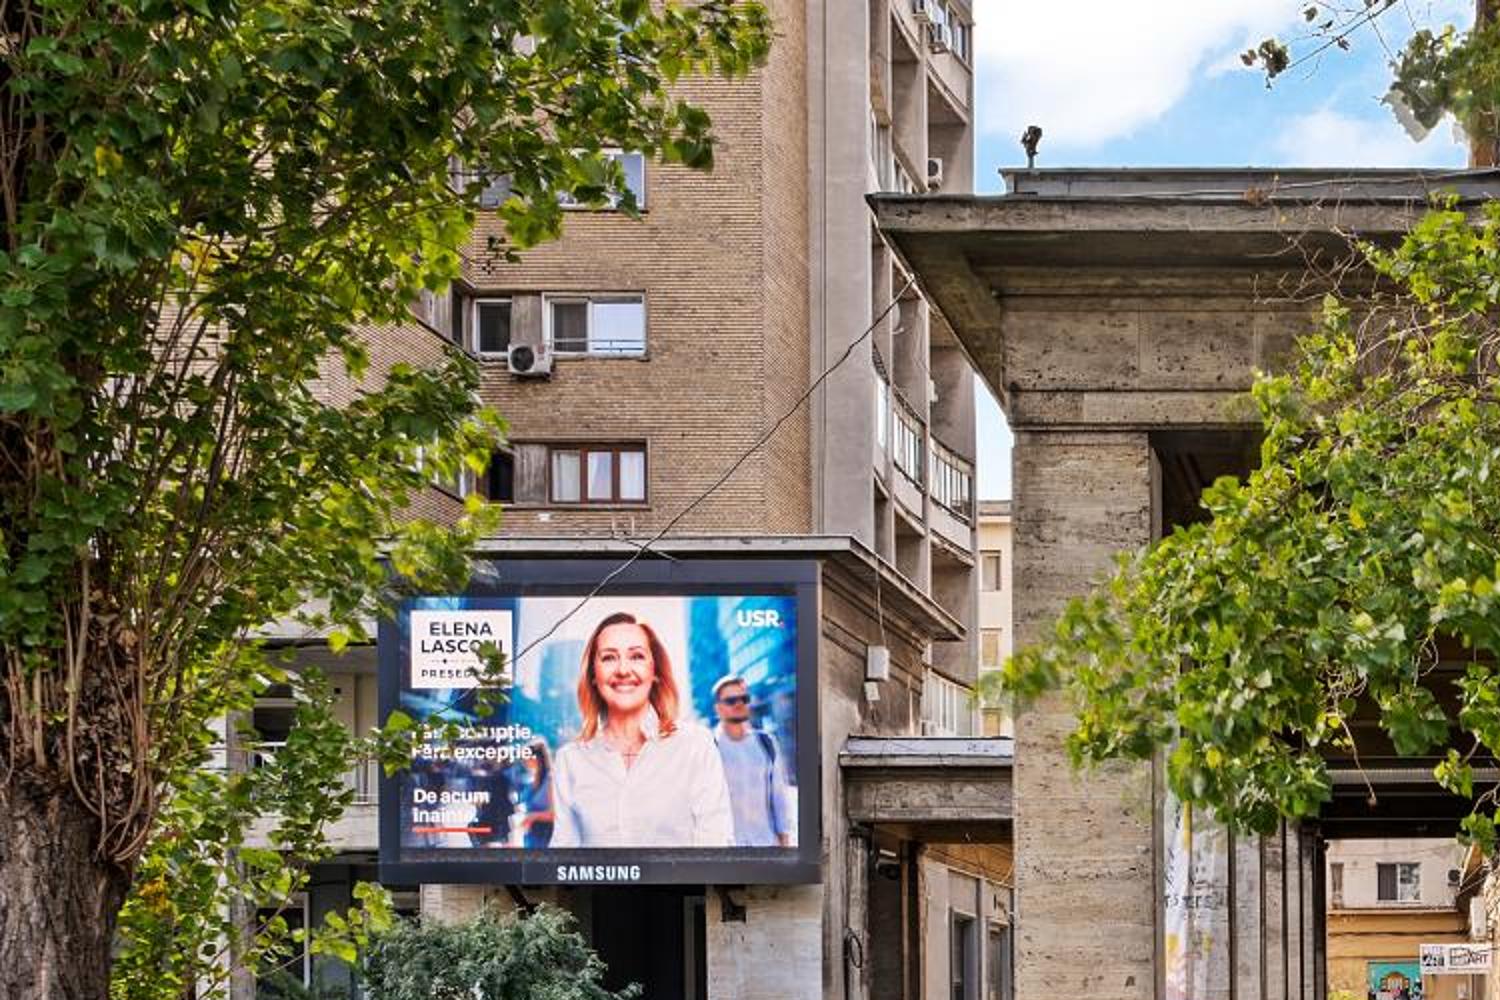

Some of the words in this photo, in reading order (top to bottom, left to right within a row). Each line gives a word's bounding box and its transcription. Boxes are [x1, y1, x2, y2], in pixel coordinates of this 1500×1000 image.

[429, 621, 493, 636] ELENA
[421, 639, 503, 653] LASCOI
[413, 788, 438, 804] De
[440, 790, 490, 804] acum
[557, 865, 641, 881] SAMSUNG
